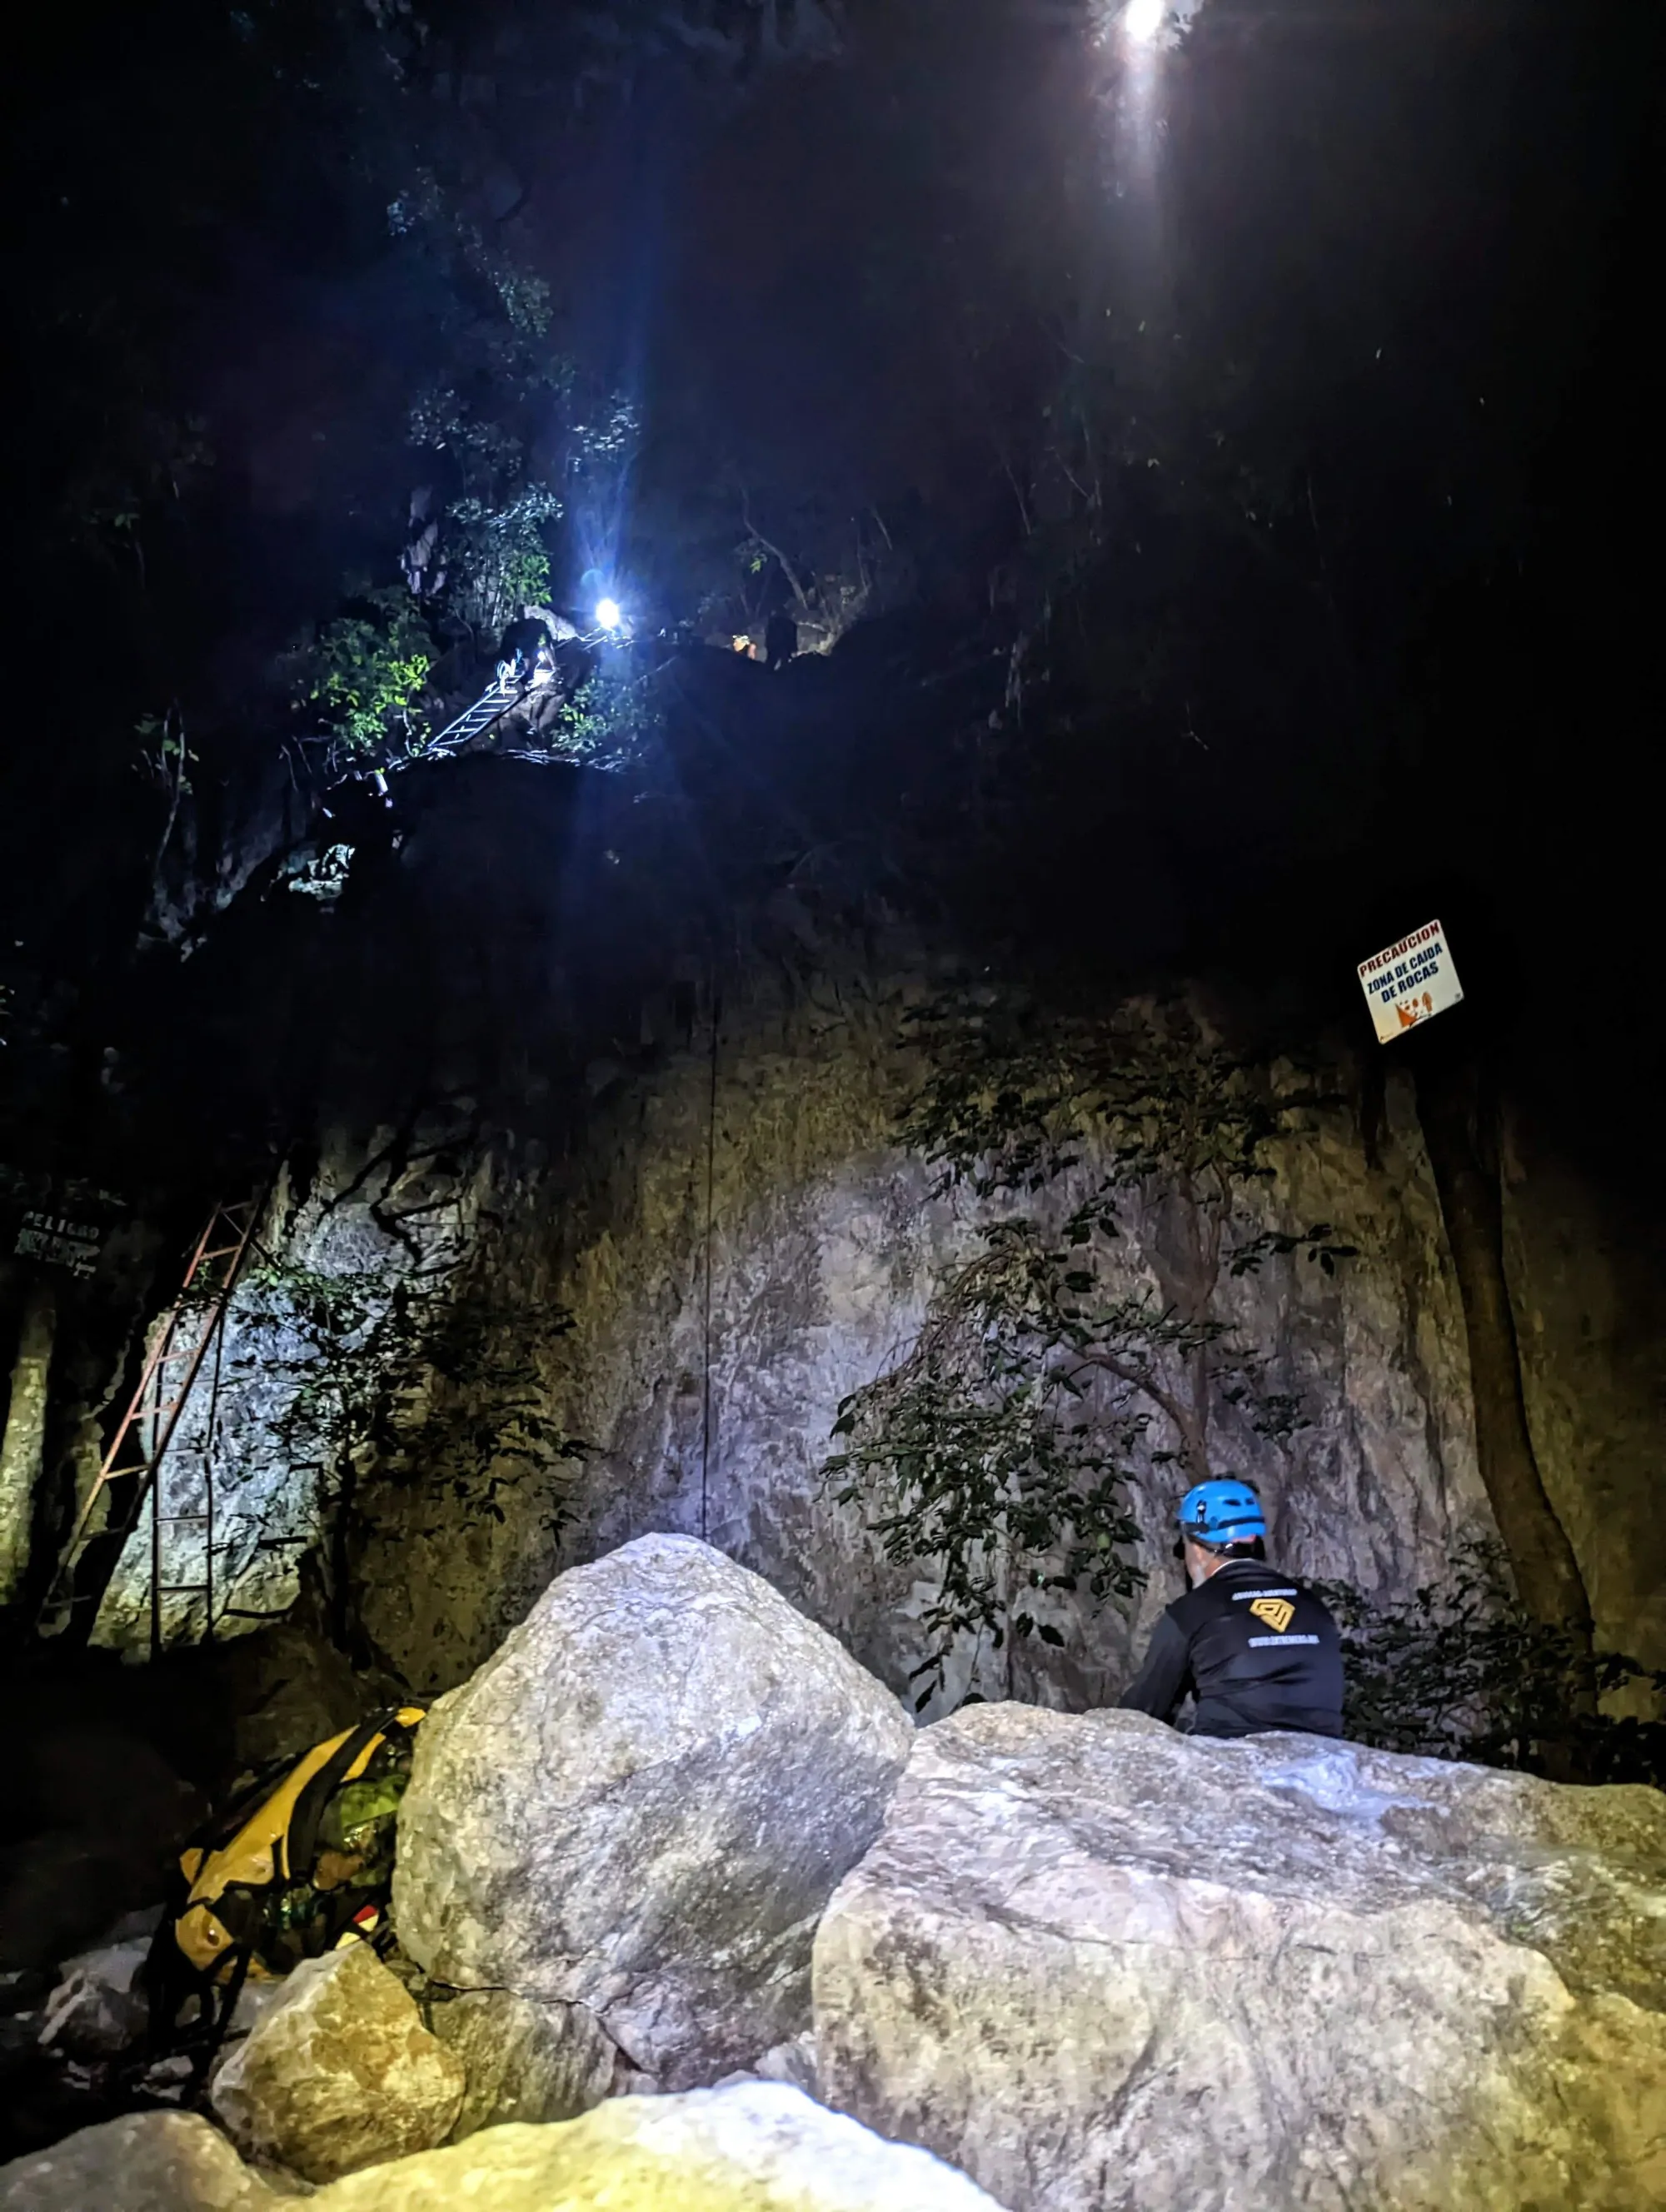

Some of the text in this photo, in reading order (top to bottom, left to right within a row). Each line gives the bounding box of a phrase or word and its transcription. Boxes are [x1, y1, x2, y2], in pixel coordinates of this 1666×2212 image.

[1359, 922, 1439, 977] PRECAUCION
[1367, 943, 1443, 994] ZONA DE CAIDA
[1381, 961, 1439, 1004] DE ROCAS
